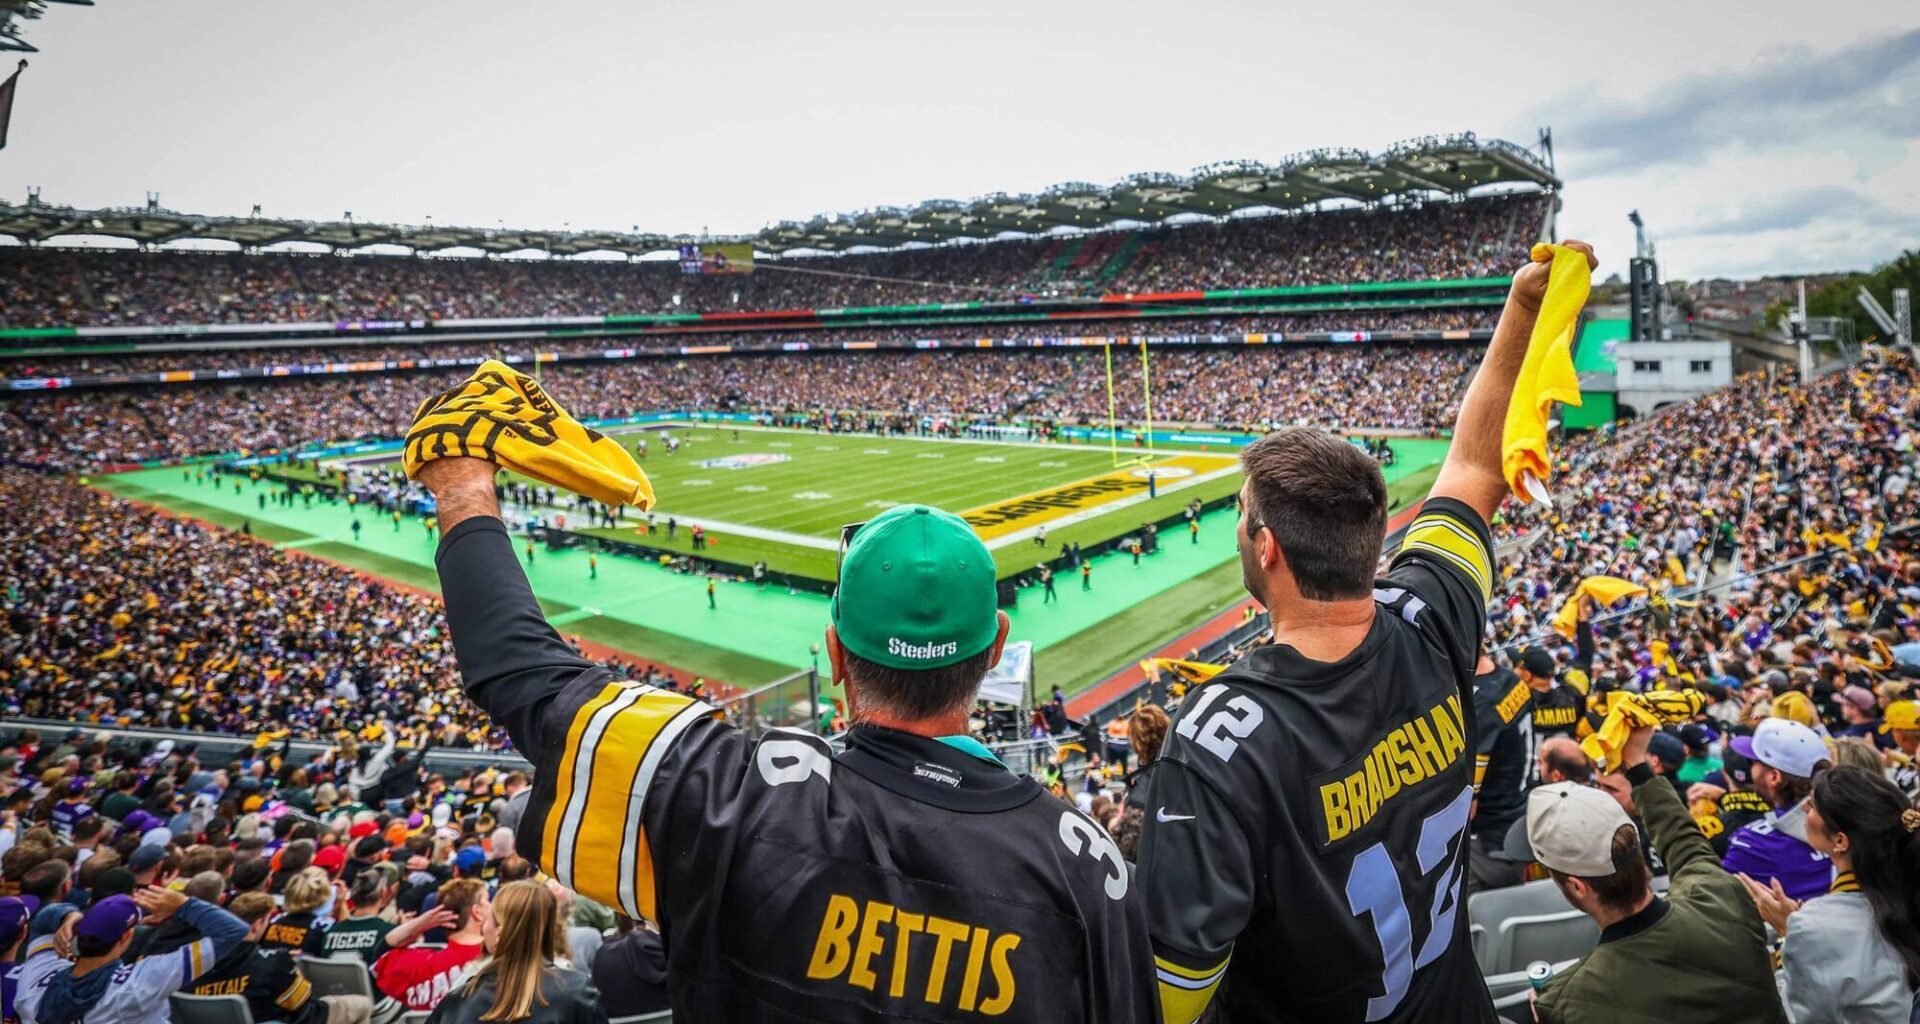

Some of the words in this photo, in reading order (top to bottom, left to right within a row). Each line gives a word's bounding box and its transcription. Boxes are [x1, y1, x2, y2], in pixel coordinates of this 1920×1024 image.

[888, 637, 957, 659] Steelers
[1175, 683, 1263, 763] 12
[1059, 811, 1128, 900] 3
[324, 930, 379, 949] TIGERS
[1345, 784, 1474, 1023] 12
[194, 975, 250, 997] METCALF
[806, 894, 1022, 1016] BETTIS
